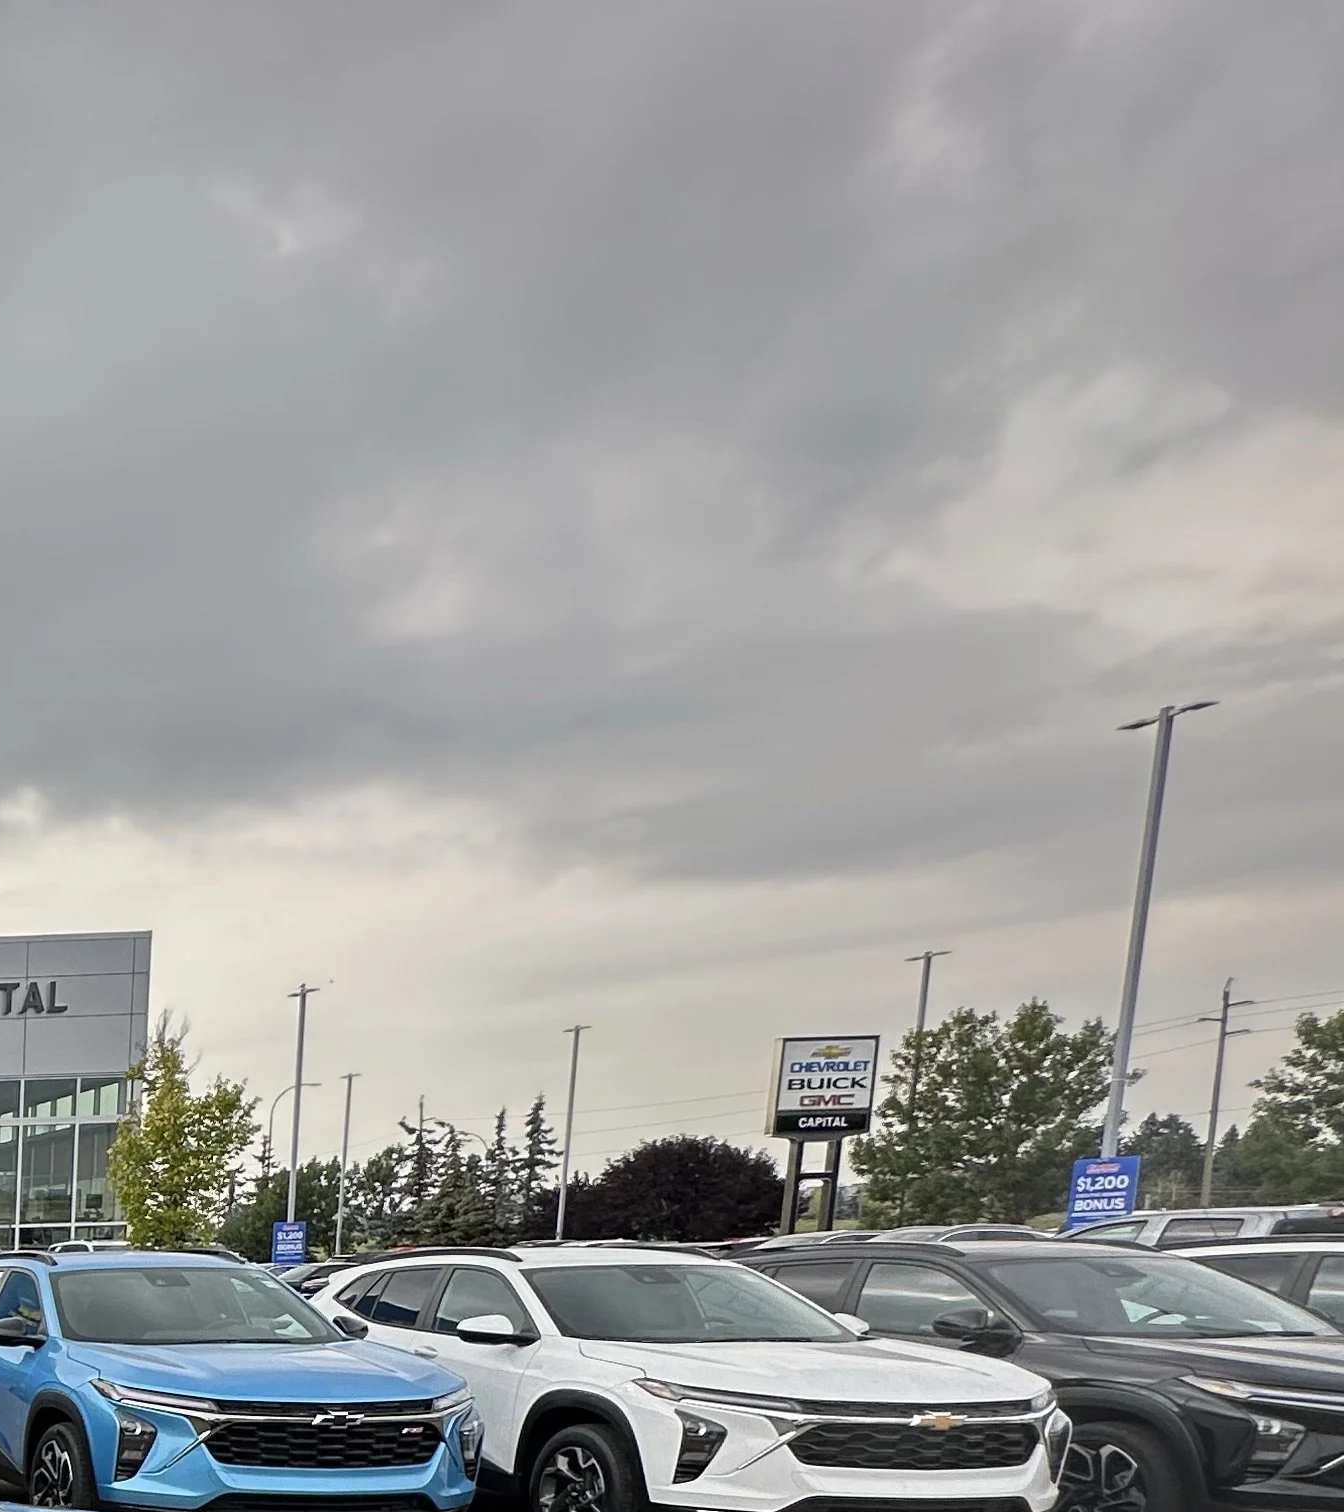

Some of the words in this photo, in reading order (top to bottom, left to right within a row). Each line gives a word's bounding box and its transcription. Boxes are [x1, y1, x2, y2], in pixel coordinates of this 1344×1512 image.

[790, 1060, 870, 1073] CHEVROLET
[787, 1076, 868, 1091] BUICK
[799, 1093, 855, 1107] GMC
[798, 1116, 849, 1128] CAPITAL
[1076, 1175, 1130, 1193] $1,200
[1073, 1197, 1126, 1212] BONUS
